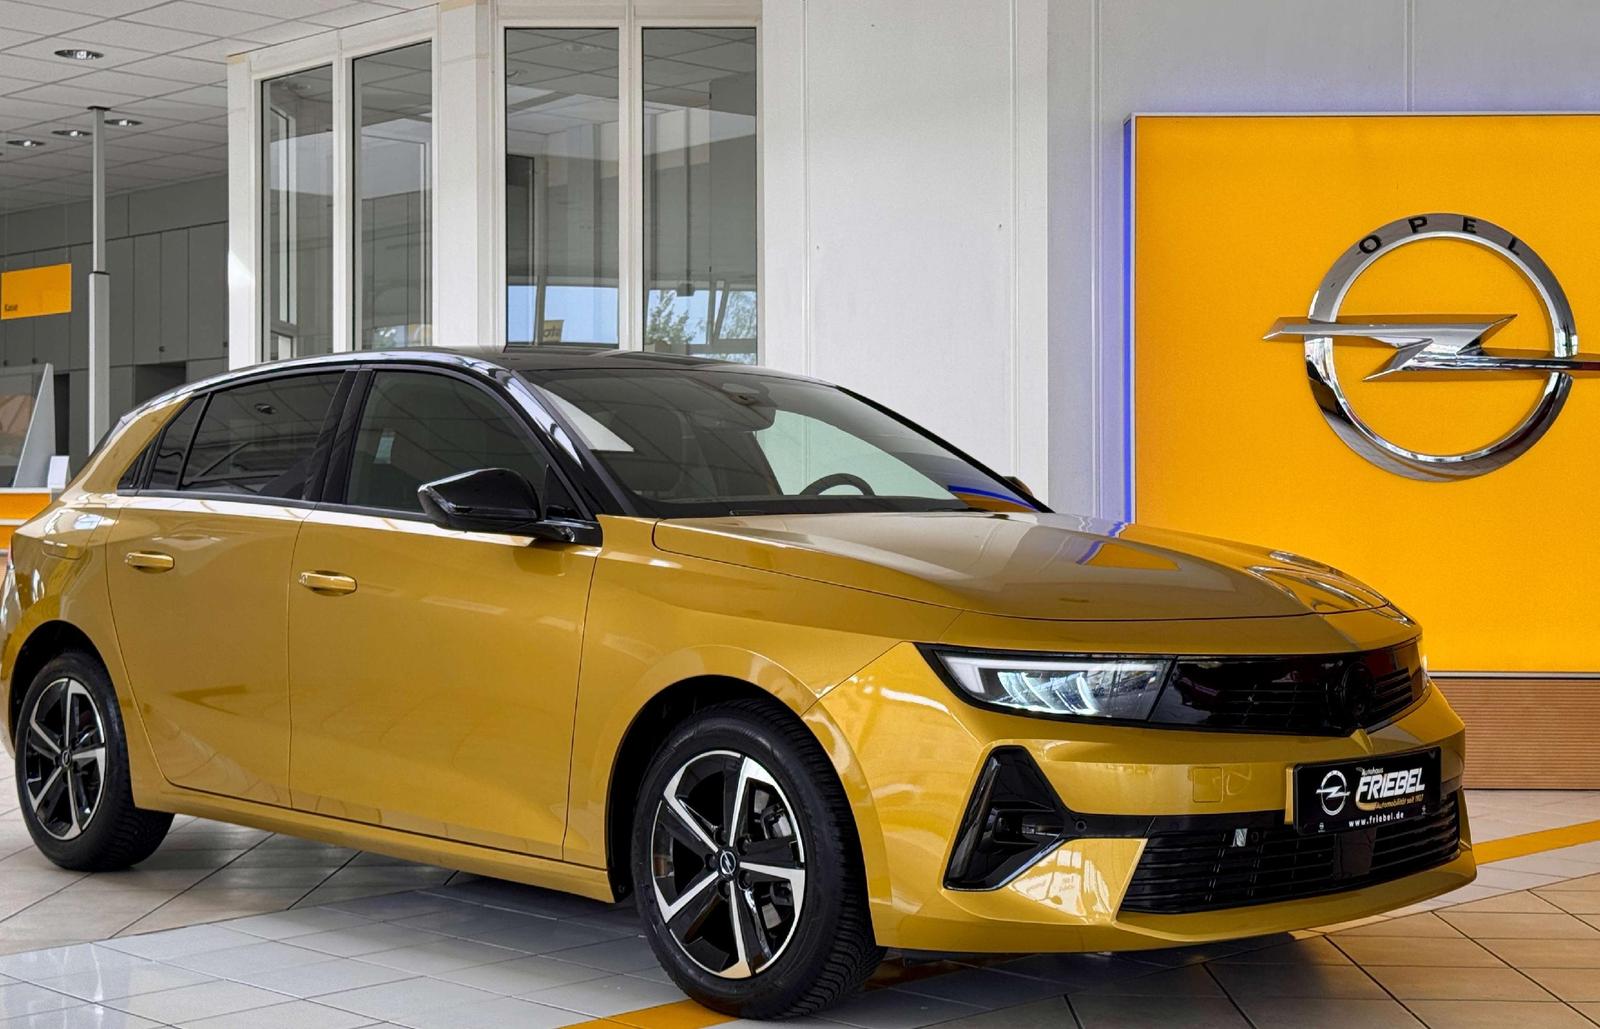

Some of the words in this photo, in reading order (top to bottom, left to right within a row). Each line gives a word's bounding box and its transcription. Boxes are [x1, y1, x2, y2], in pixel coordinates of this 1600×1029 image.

[1359, 216, 1520, 255] OPEL
[1361, 766, 1384, 776] Autohaus
[1357, 768, 1425, 801] FRIEBEL
[1349, 811, 1404, 827] www.friebel.de
